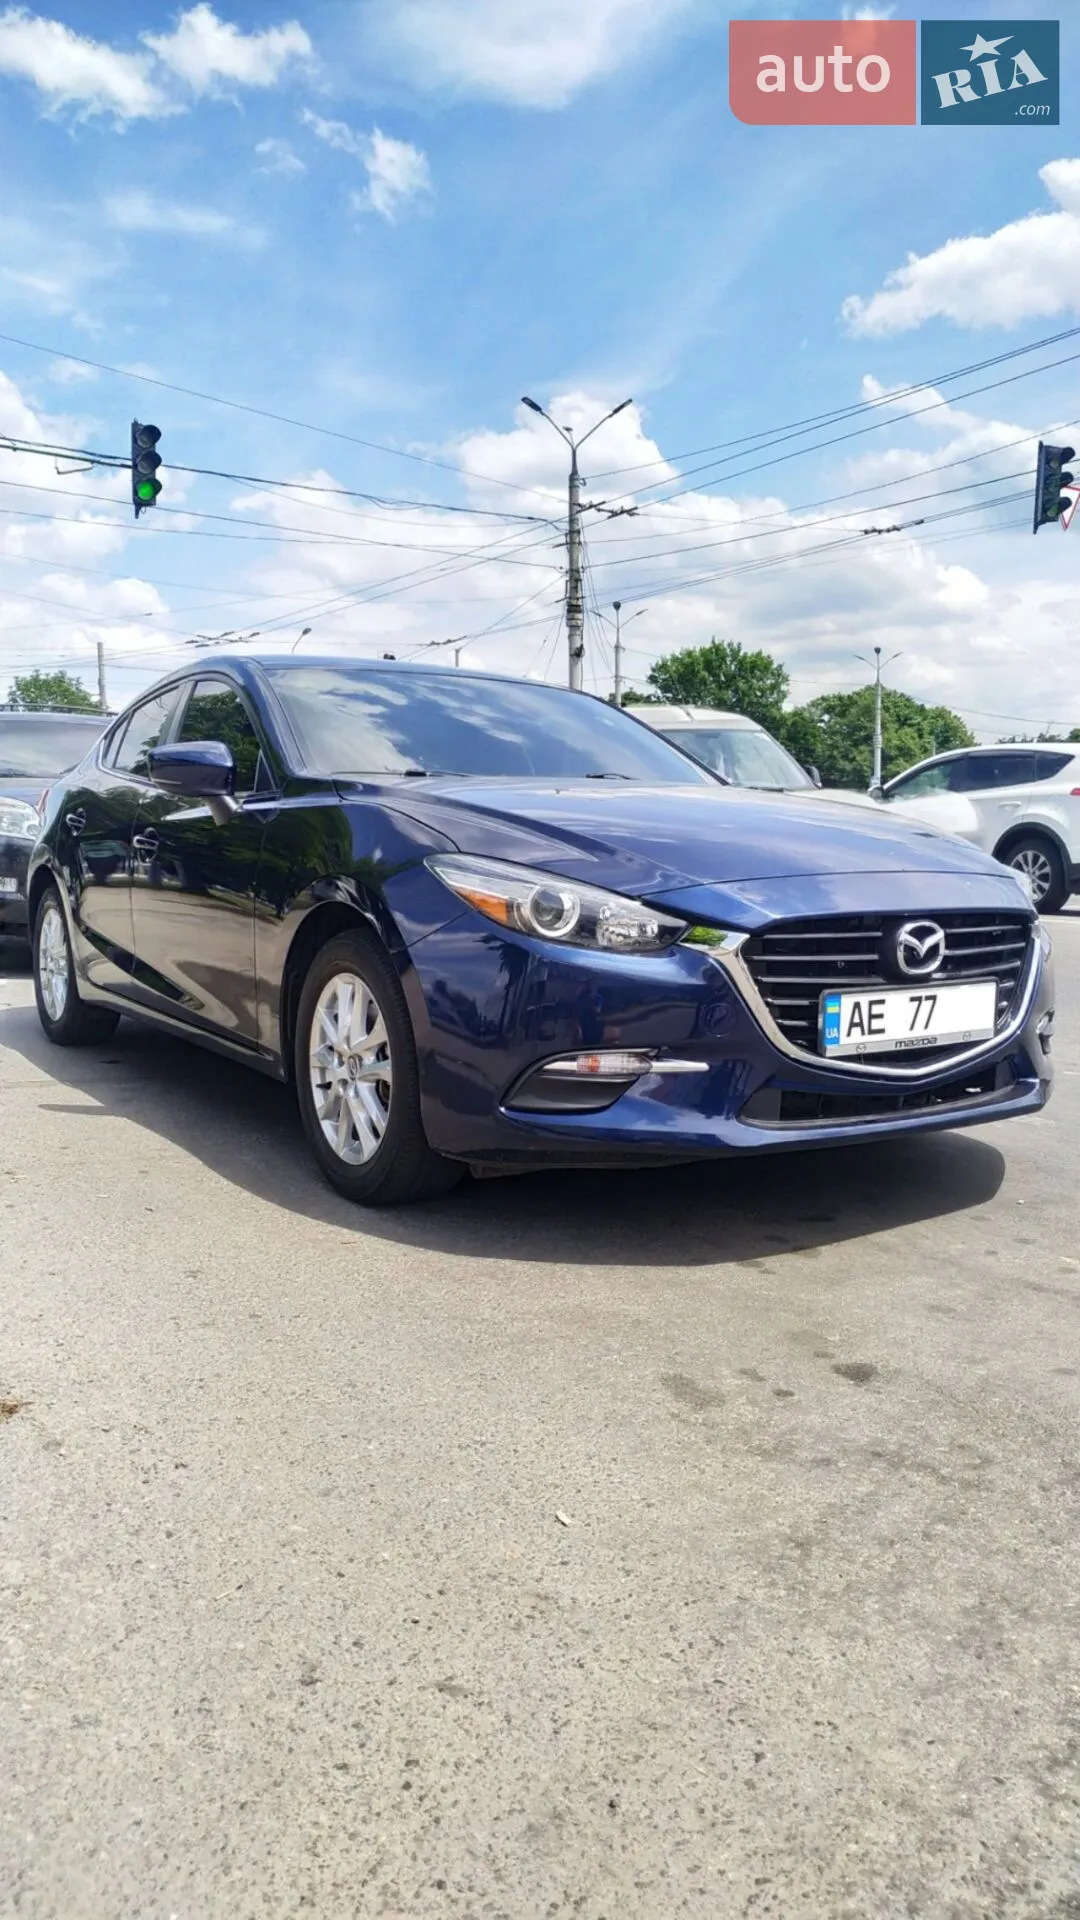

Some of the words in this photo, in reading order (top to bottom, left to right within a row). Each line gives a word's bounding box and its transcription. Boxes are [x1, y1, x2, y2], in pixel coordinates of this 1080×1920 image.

[846, 999, 886, 1037] AE
[909, 995, 937, 1031] 77
[825, 1027, 839, 1039] UA
[894, 1036, 938, 1049] mazda
